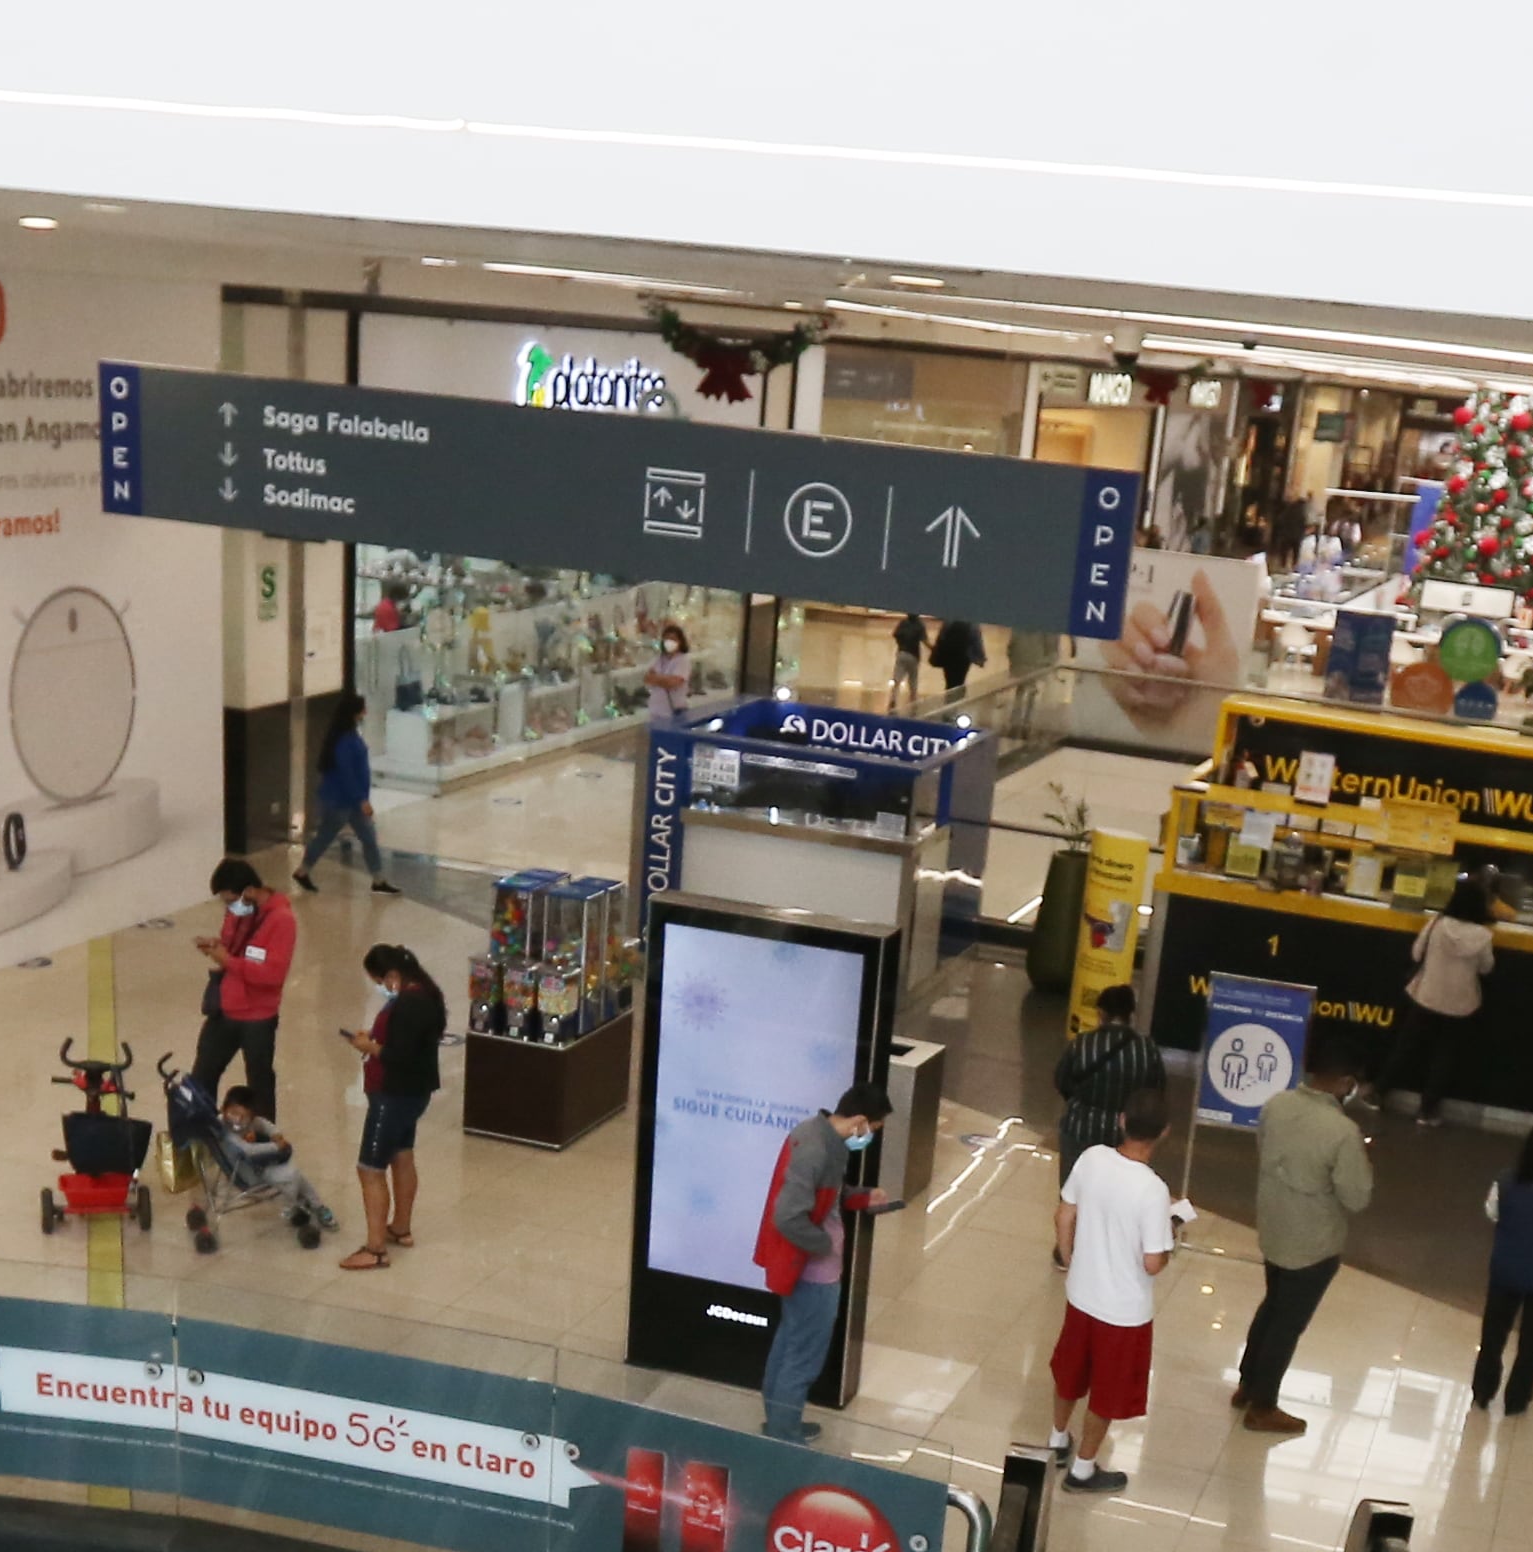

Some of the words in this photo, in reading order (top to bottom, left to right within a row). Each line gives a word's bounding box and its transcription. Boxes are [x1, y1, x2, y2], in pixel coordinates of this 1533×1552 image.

[23, 416, 101, 450] Angamo
[109, 375, 131, 501] OPEN
[263, 404, 318, 435] Saga
[326, 411, 430, 444] Falabella
[263, 447, 327, 475] Tottus
[263, 484, 356, 514] Sodimac
[801, 499, 835, 540] E
[1084, 486, 1121, 623] OPEN
[811, 718, 903, 753] DOLLAR
[654, 747, 678, 807] CITY
[1264, 754, 1480, 813] WternUnion
[647, 814, 673, 900] OLLAR
[1267, 934, 1280, 957] 1
[673, 1095, 719, 1118] SIGUE
[724, 1105, 801, 1132] CUIDAND
[35, 1371, 194, 1415] Encuentra
[203, 1394, 231, 1422] tu
[239, 1406, 338, 1443] equipo
[345, 1412, 398, 1452] 5G
[411, 1439, 447, 1463] en
[456, 1442, 536, 1480] Claro
